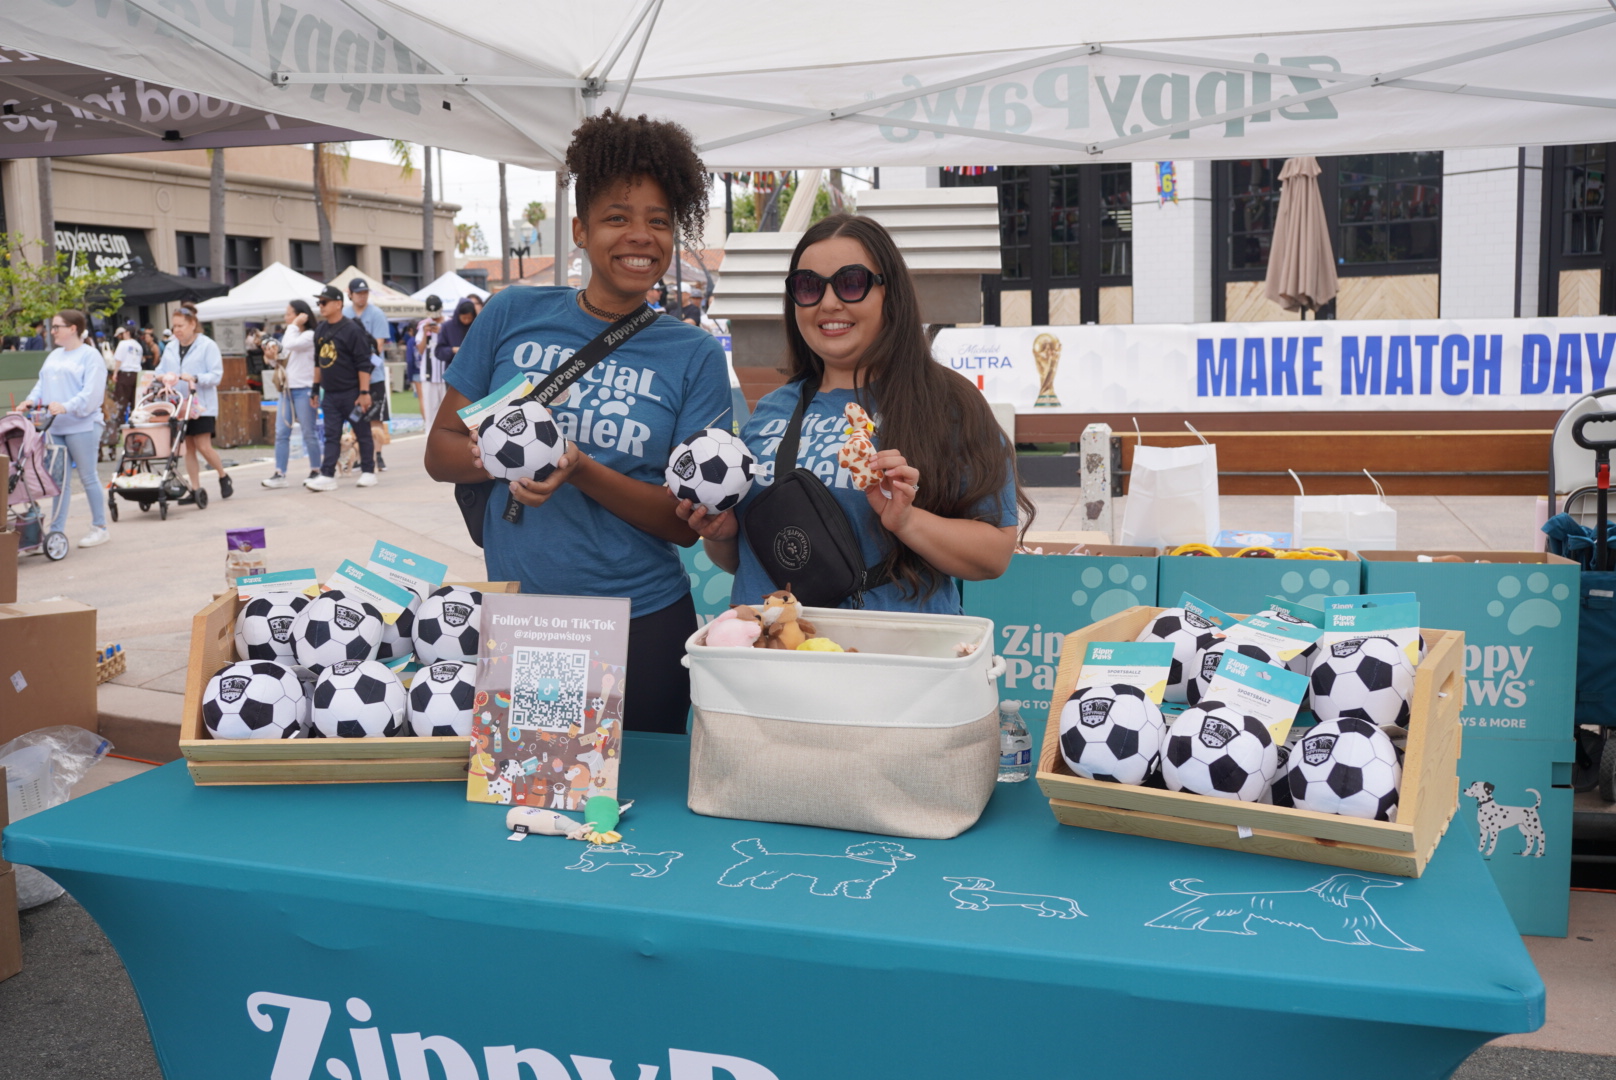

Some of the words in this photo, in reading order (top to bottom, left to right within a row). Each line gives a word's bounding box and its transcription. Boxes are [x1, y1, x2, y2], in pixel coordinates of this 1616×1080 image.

[950, 356, 1013, 370] ULTRA
[1197, 336, 1323, 397] MAKE
[1341, 333, 1503, 396] MATCH
[1520, 332, 1616, 395] DAY
[533, 358, 587, 405] ippyPaws
[492, 614, 533, 626] Follow
[534, 616, 549, 628] Us
[551, 617, 568, 629] On
[571, 618, 616, 631] TikTok
[1092, 647, 1115, 656] Zippy
[1225, 664, 1246, 677] Paws
[1227, 657, 1250, 672] Zippy
[1237, 687, 1272, 705] SPORTSBALLZ
[1478, 717, 1488, 728] &
[1489, 718, 1527, 729] MORE
